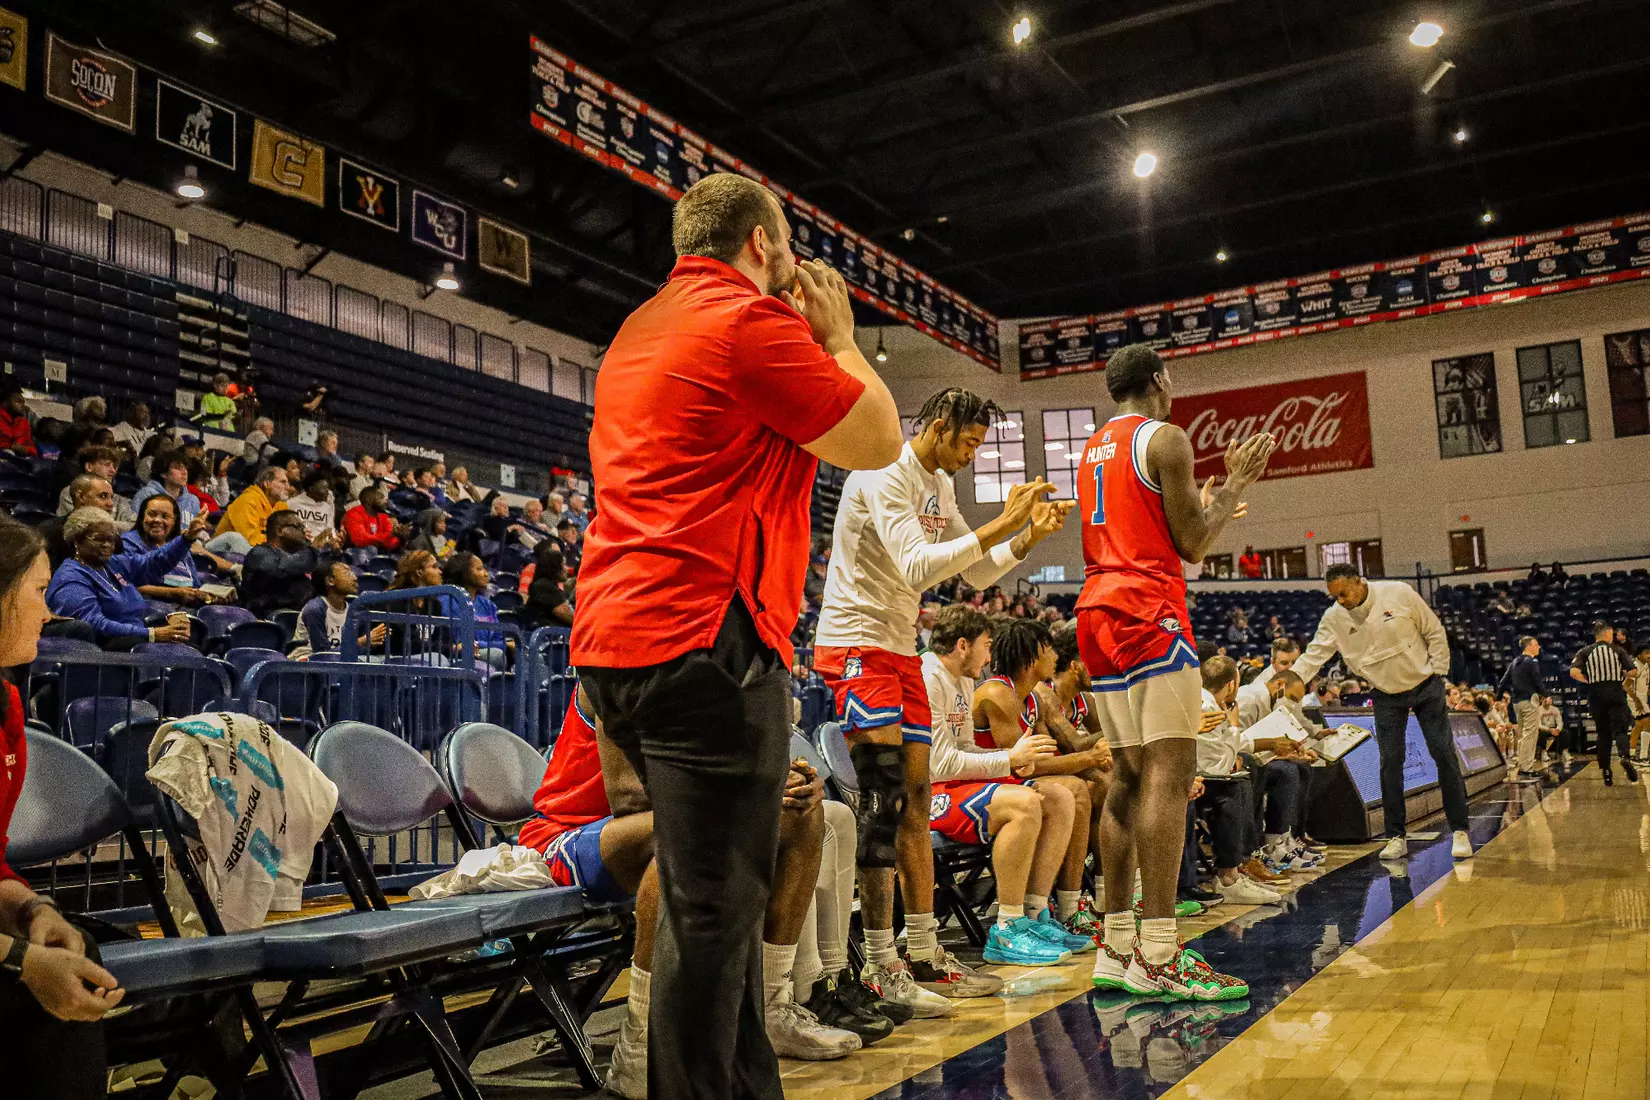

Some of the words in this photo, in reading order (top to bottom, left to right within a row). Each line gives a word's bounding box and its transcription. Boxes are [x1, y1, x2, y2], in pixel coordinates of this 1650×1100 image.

[179, 133, 211, 156] SAM
[1300, 297, 1333, 313] WNIT
[1185, 391, 1350, 454] Coca-Cola
[388, 440, 419, 457] Reserved
[420, 446, 445, 462] Seating
[1086, 442, 1117, 463] HUNTER
[1267, 462, 1308, 477] Samford
[1310, 458, 1354, 472] Athletics
[1090, 462, 1107, 526] 1
[297, 509, 328, 523] NASA
[222, 785, 262, 873] POWERADE
